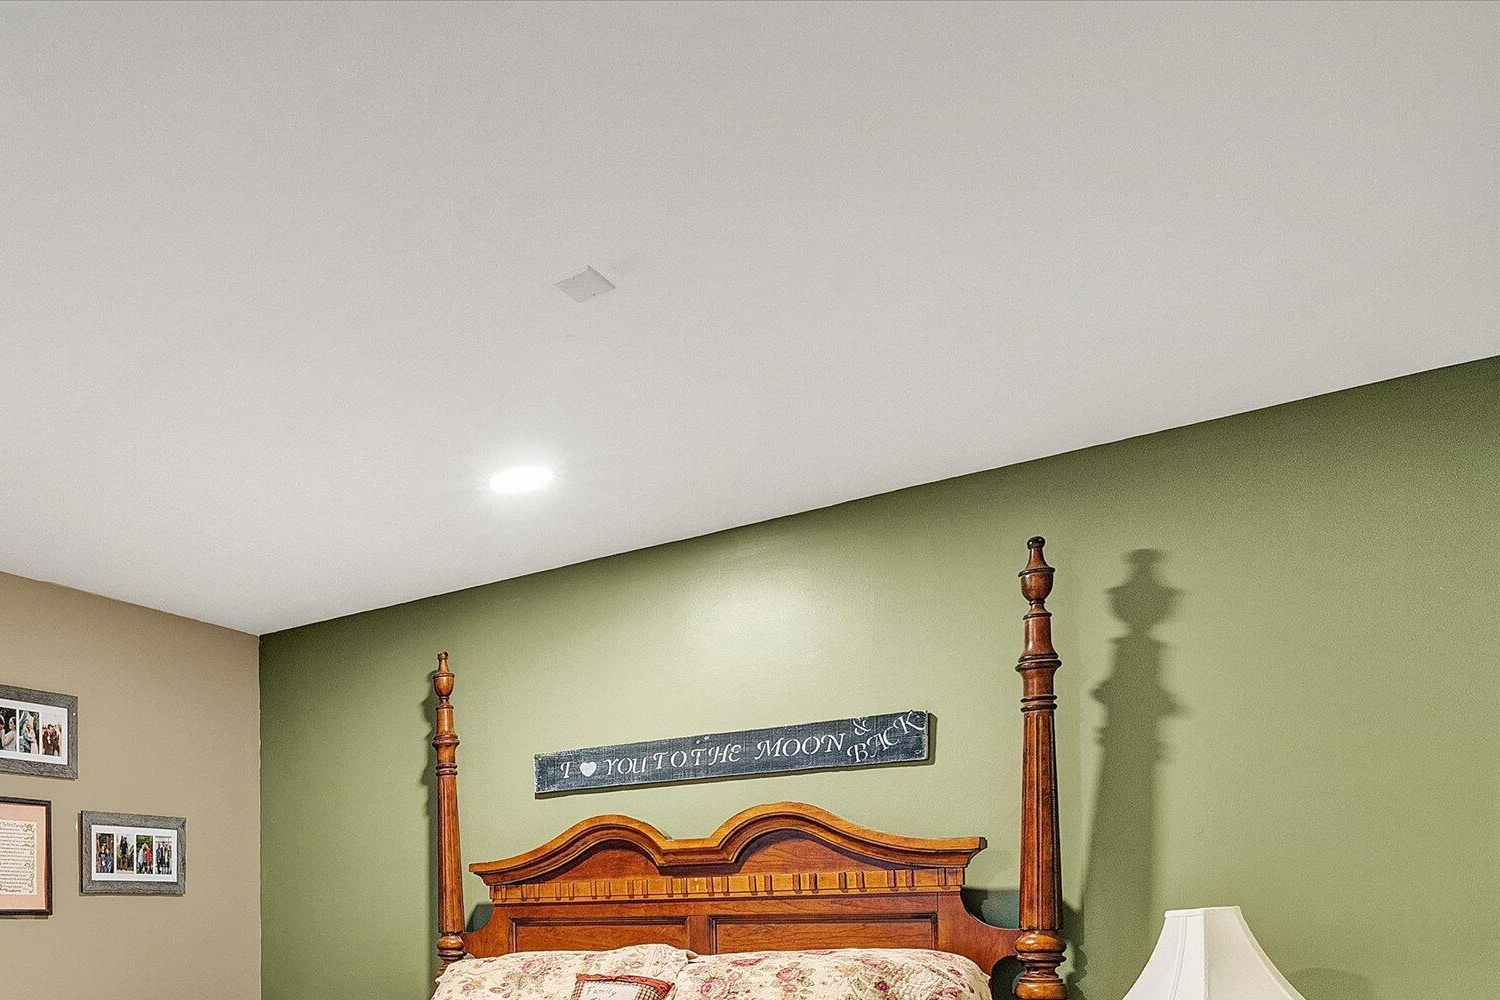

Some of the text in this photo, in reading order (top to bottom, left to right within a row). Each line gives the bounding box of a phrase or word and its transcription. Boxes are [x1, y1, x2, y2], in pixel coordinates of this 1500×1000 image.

[847, 709, 926, 763] BACK
[854, 717, 871, 735] &
[755, 733, 844, 761] MOON
[560, 762, 571, 779] I
